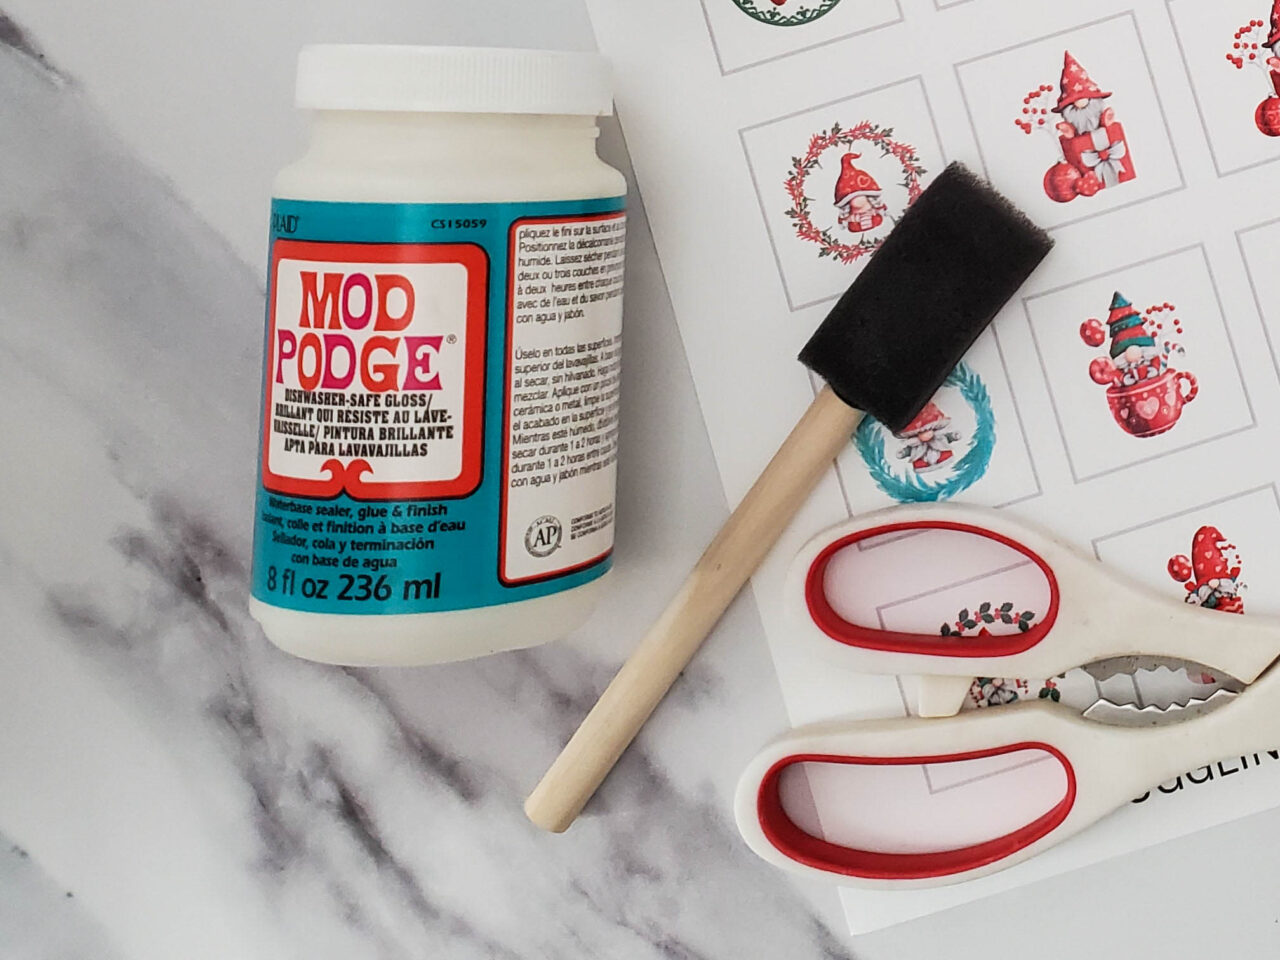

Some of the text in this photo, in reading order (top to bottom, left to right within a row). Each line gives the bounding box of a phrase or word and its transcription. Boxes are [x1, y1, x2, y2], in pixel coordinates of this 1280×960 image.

[430, 217, 488, 230] CS15059
[299, 270, 416, 331] MOD
[275, 329, 445, 393] PODGE
[285, 389, 381, 408] DISHWASHER-SAFE
[275, 403, 314, 422] BRILLANT
[316, 409, 334, 423] QUI
[393, 410, 411, 424] AU
[323, 426, 375, 441] PINTURA
[378, 425, 454, 441] BRILLANTE
[284, 438, 429, 458] APTA PARA LAVAVAJILLAS
[316, 503, 354, 519] sealer,
[357, 505, 388, 521] glue
[391, 505, 403, 518] &
[406, 504, 448, 518] finish
[287, 517, 309, 531] colle
[312, 521, 324, 533] et
[326, 520, 375, 535] finition
[390, 521, 424, 534] base
[312, 537, 336, 550] cola
[338, 541, 347, 555] y
[350, 538, 435, 552] terminación
[533, 525, 557, 548] AP
[291, 552, 398, 572] con base de agua
[267, 565, 442, 602] 8 fl oz 236 ml
